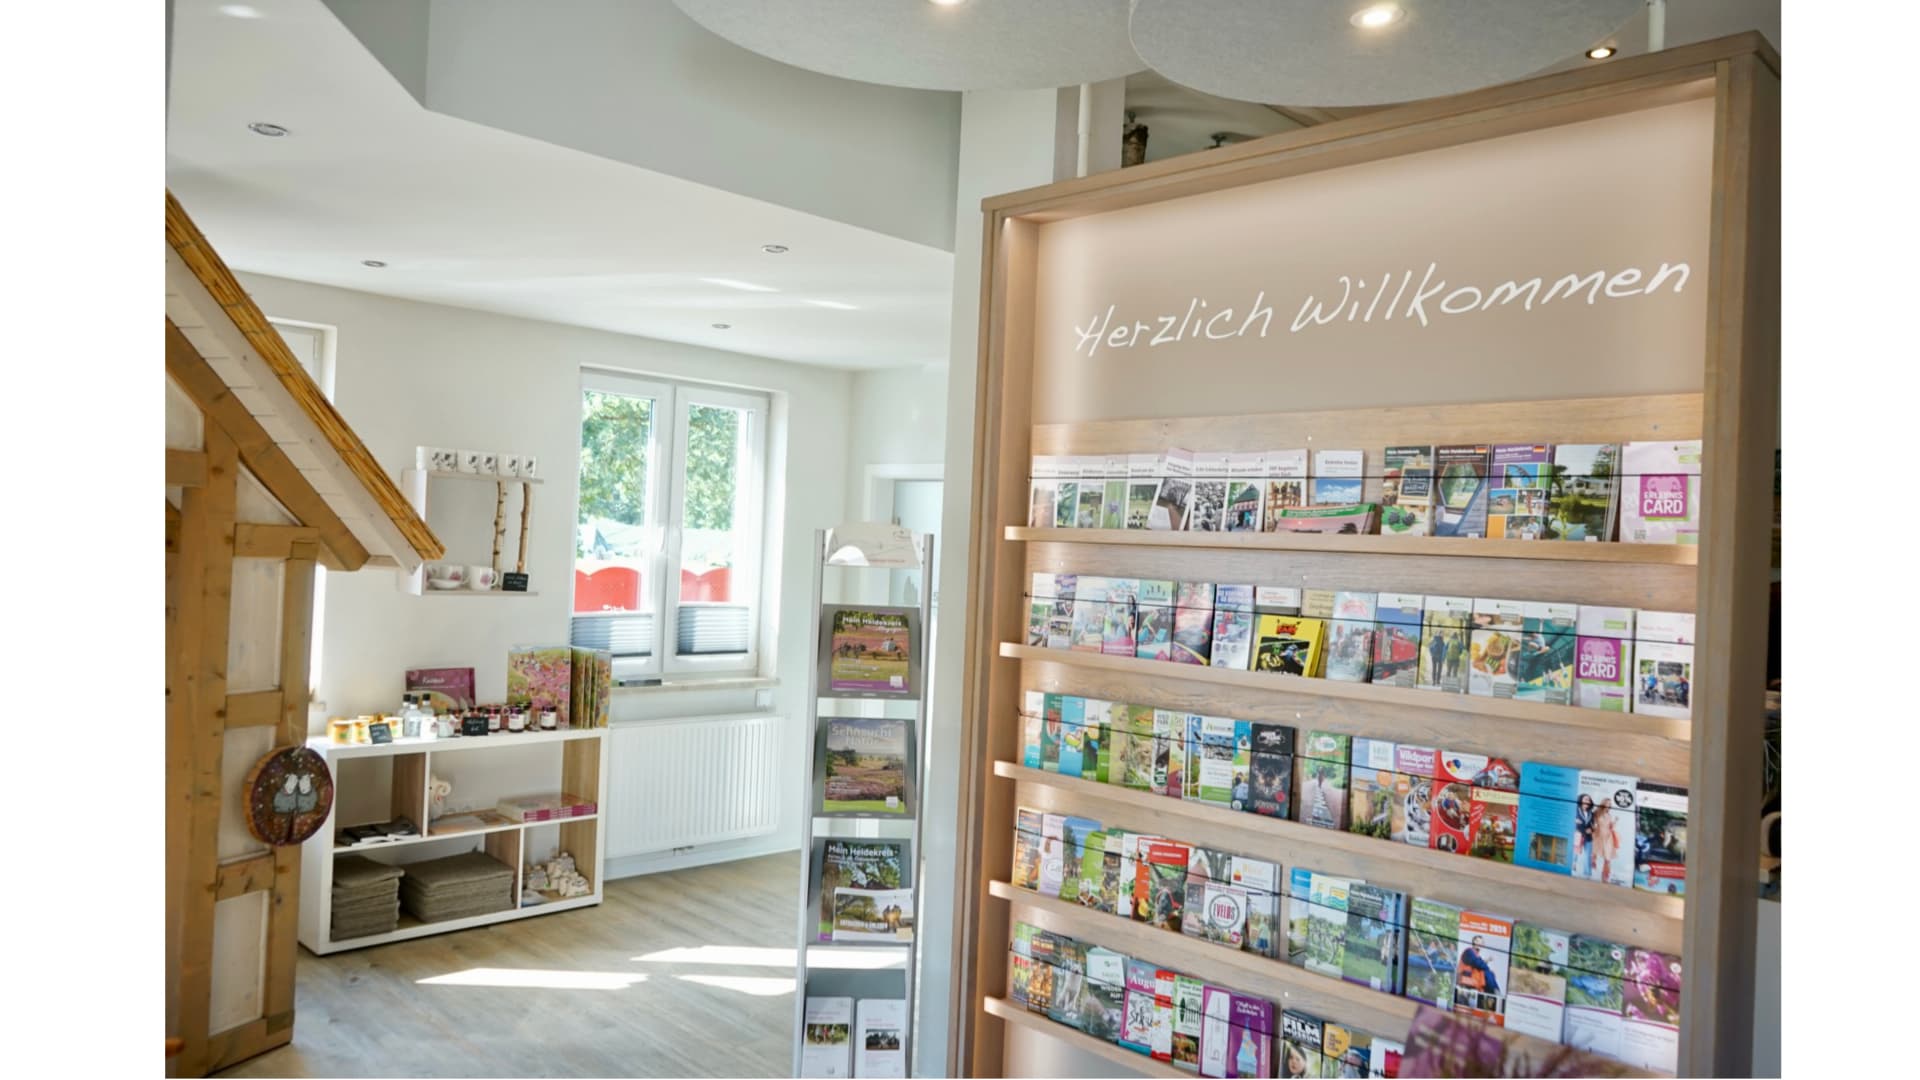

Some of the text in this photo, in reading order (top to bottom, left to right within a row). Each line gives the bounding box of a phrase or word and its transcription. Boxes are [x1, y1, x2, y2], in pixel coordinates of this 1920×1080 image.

[1074, 262, 1691, 357] Herzlich Willkommen
[1643, 499, 1684, 515] CARD
[1579, 661, 1617, 680] CARD
